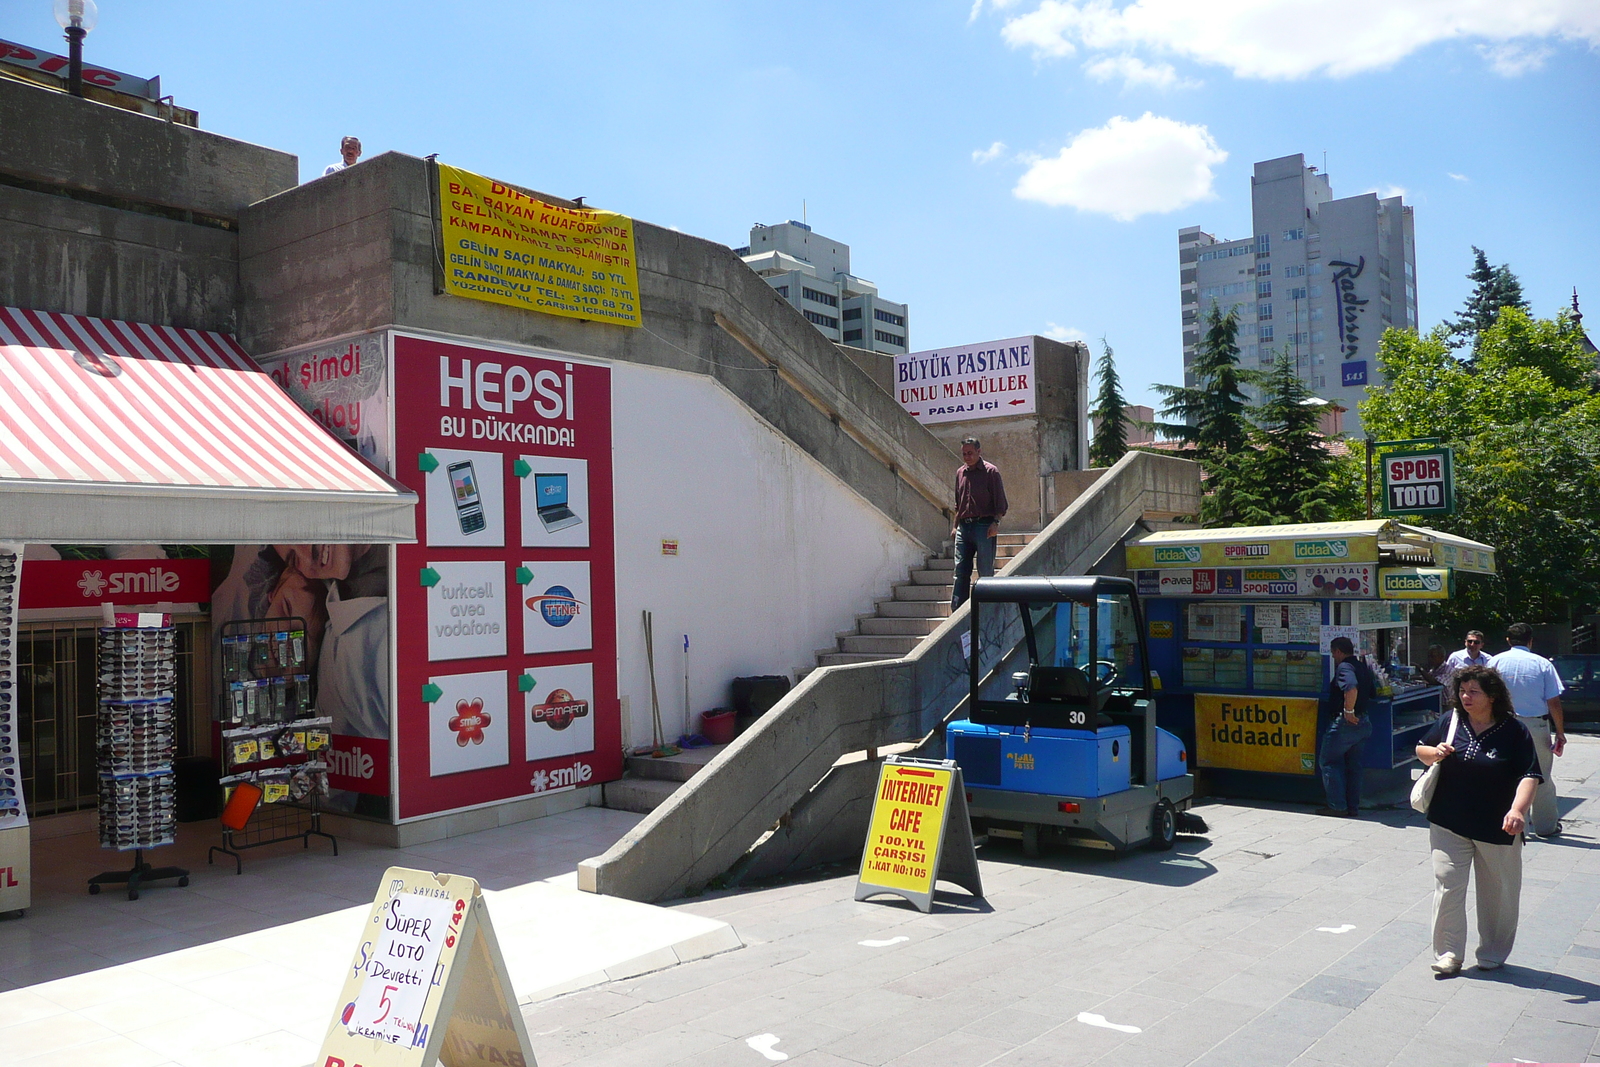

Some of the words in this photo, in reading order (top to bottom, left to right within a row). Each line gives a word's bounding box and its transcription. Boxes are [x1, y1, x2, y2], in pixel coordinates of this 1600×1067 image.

[483, 196, 534, 220] BAYAN
[540, 213, 628, 238] KUAFÖRÜNDE
[449, 216, 551, 250] KAMPANYAMIZ
[555, 244, 630, 267] BAŞLAMIŞTIR
[520, 223, 567, 242] DAMAT
[573, 237, 628, 252] SAÇINDA
[459, 239, 499, 257] GELİN
[504, 250, 535, 265] SAÇI
[538, 257, 585, 277] MAKYAJ:
[592, 271, 605, 280] 50
[608, 272, 626, 285] YTL
[450, 253, 481, 267] GELİN
[484, 260, 503, 275] SAÇI
[506, 266, 545, 282] MAKYAJ
[547, 275, 554, 284] &
[556, 277, 580, 291] DAMAT
[582, 283, 606, 295] SAÇI:
[611, 287, 619, 298] 75
[620, 290, 634, 300] YTL
[452, 280, 512, 297] YÜZÜNCÜ
[516, 294, 533, 303] YIL
[536, 298, 579, 311] ÇARŞISI
[582, 305, 636, 321] İÇERİSİNDE
[453, 268, 531, 292] RANDEVU
[536, 286, 565, 300] TEL:
[572, 295, 598, 305] 310
[602, 299, 616, 308] 68
[619, 302, 633, 311] 79
[1328, 255, 1369, 360] Radisson
[300, 344, 360, 389] şimdi
[898, 353, 951, 382] BÜYÜK
[956, 345, 1031, 375] PASTANE
[1344, 371, 1364, 381] SAS
[900, 385, 938, 403] UNLU
[943, 374, 1028, 400] MAMÜLLER
[928, 403, 975, 416] PASAJ
[979, 400, 999, 413] İÇİ
[440, 415, 466, 438] BU
[472, 416, 575, 447] DÜKKANDA!
[1390, 458, 1440, 481] SPOR
[1394, 484, 1440, 507] TOTO
[1156, 548, 1185, 561] iddaa
[1296, 544, 1330, 556] iddaa
[109, 567, 180, 594] smile
[1171, 577, 1192, 585] avea
[1197, 572, 1209, 581] TEL
[1246, 570, 1280, 580] iddaa
[1387, 577, 1422, 588] iddaa
[442, 581, 494, 600] turkcell
[1243, 583, 1269, 593] SPOR
[1270, 583, 1296, 593] TOTO
[450, 604, 486, 617] avea
[545, 603, 581, 616] TTNet
[435, 619, 500, 638] vodafone
[460, 715, 481, 727] smile
[535, 703, 586, 718] D-SMART
[1069, 711, 1086, 724] 30
[1221, 703, 1288, 725] Futbol
[1211, 723, 1301, 747] iddaadır
[326, 746, 374, 779] smile
[549, 762, 593, 788] smile
[881, 774, 944, 807] İNTERNET
[889, 808, 922, 834] CAFE
[879, 834, 926, 850] 100.YIL
[873, 846, 926, 863] ÇARŞISI
[868, 860, 891, 872] 1.KAT
[893, 864, 927, 878] NO:105
[413, 886, 450, 900] SAYISAL
[386, 899, 431, 942] SÜPER
[445, 899, 465, 948] 6/49
[388, 940, 424, 961] LOTO
[370, 960, 423, 986] Devretti
